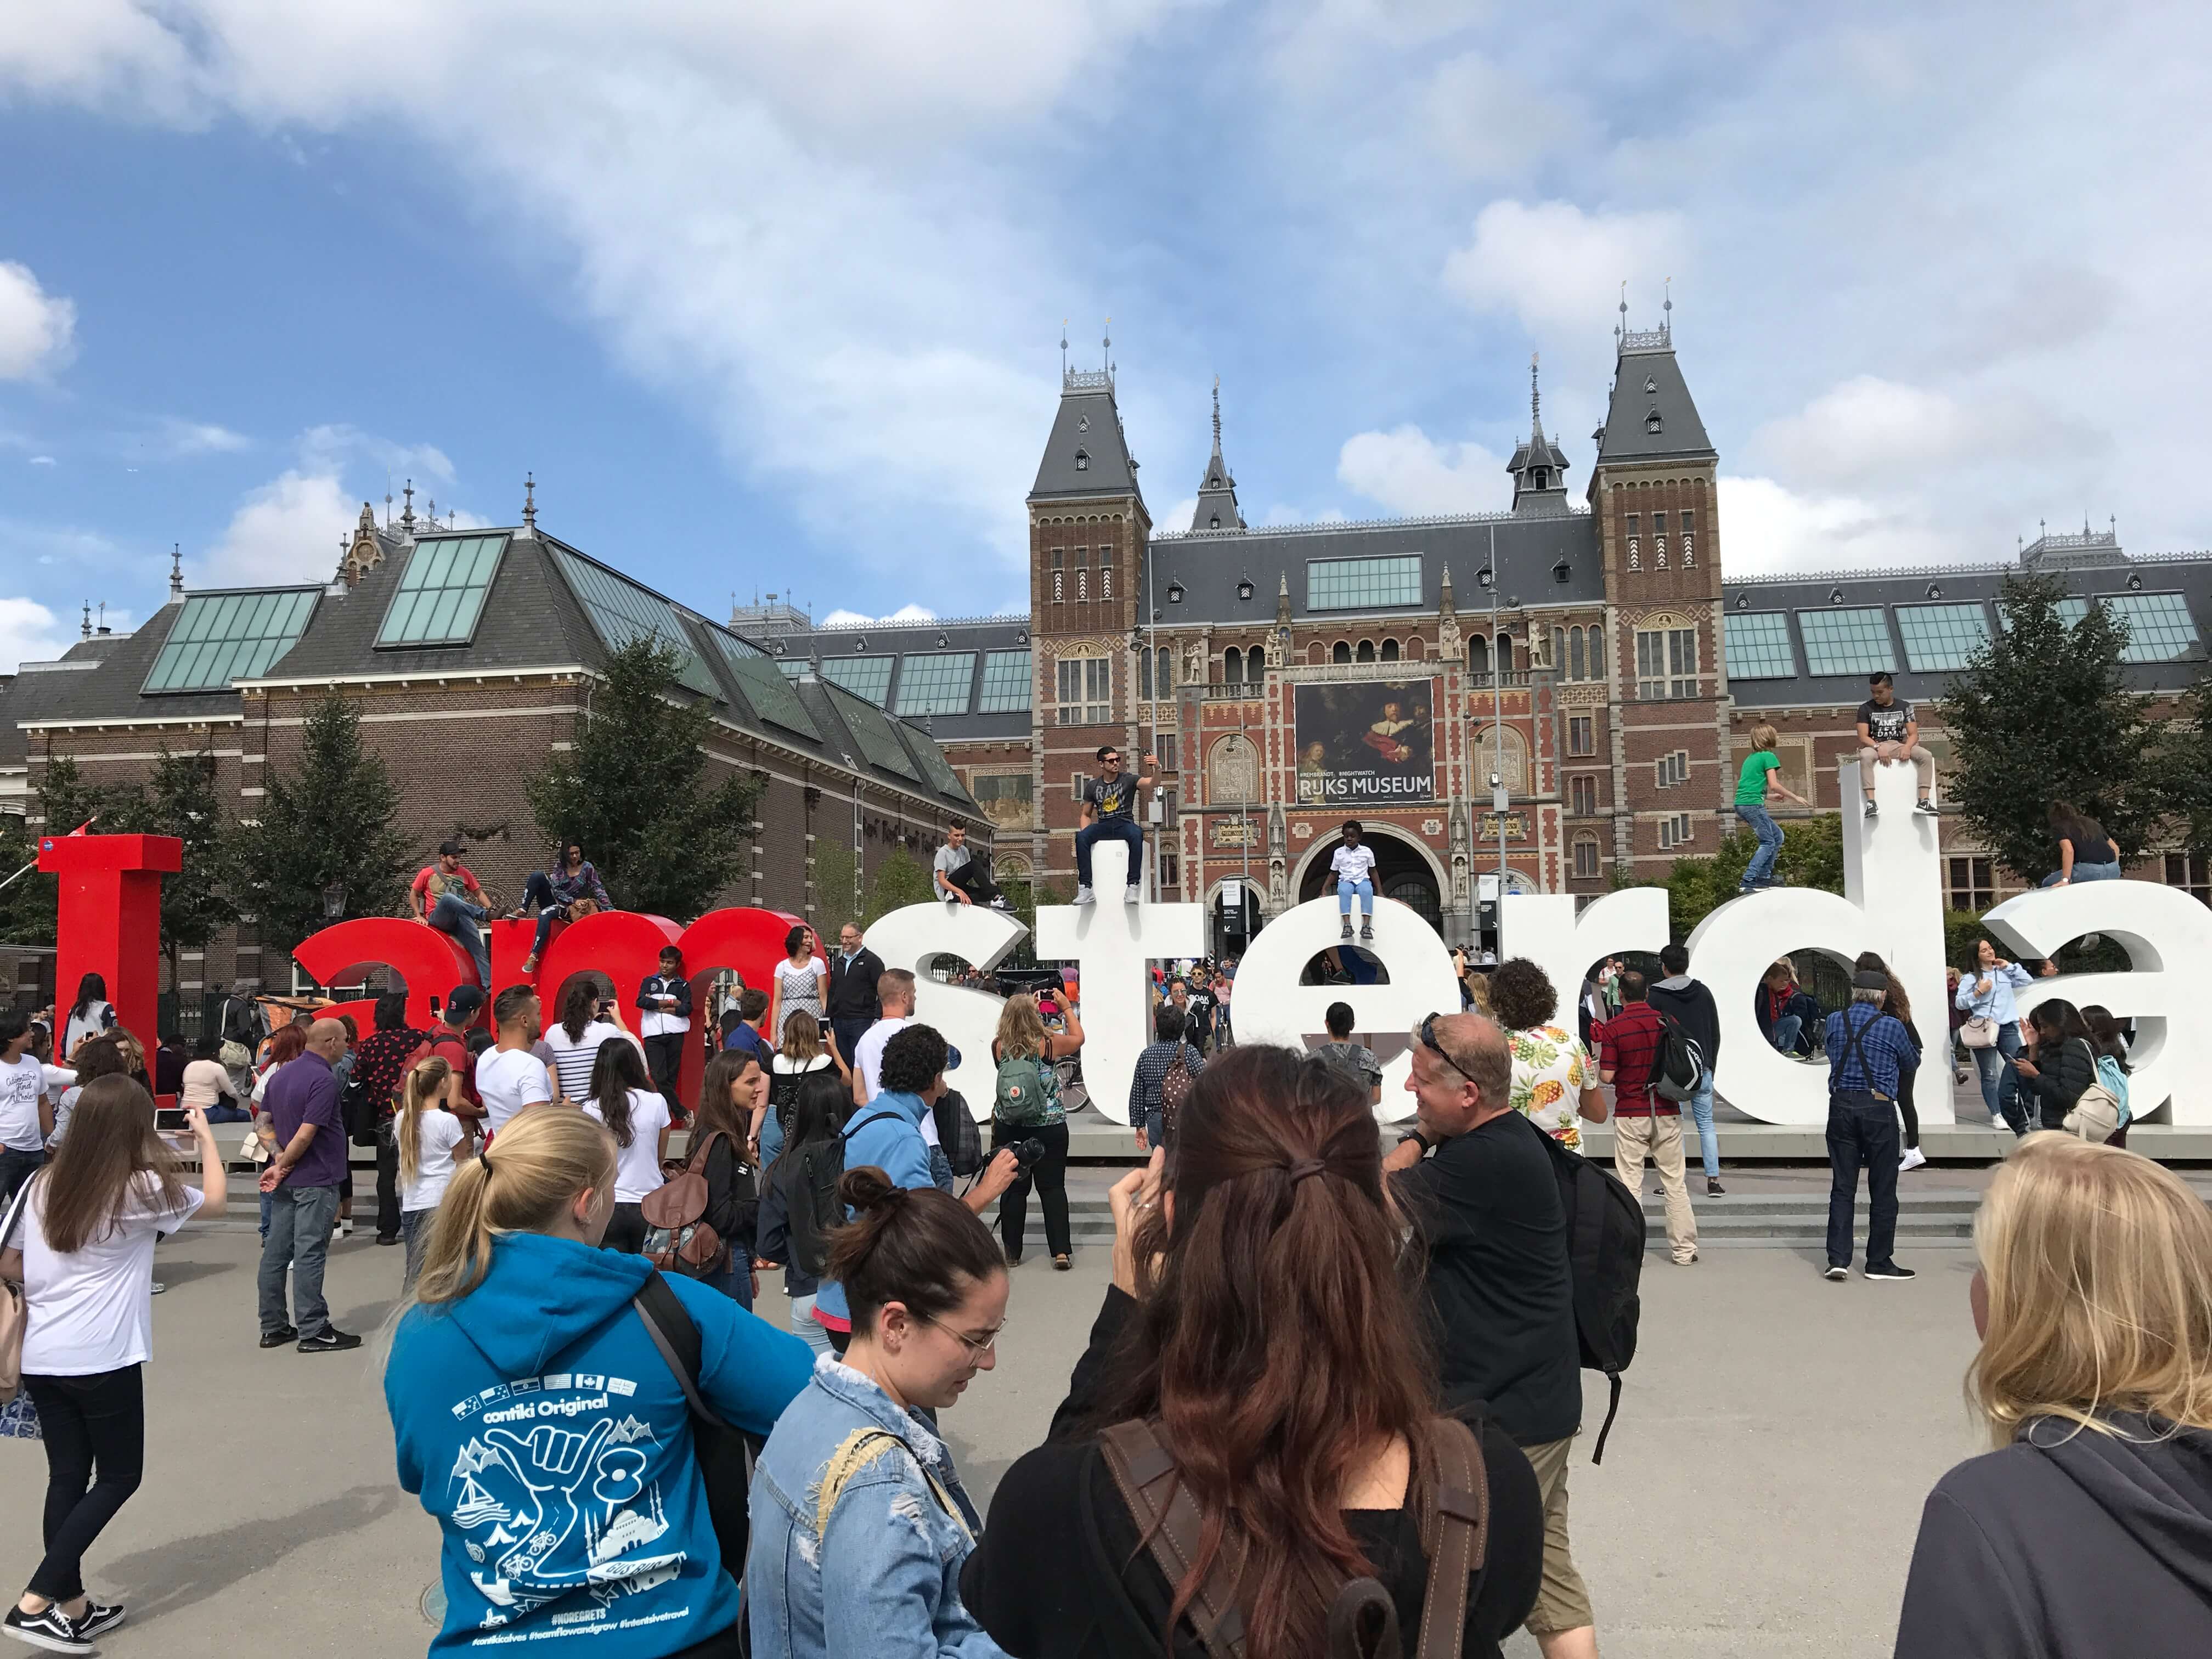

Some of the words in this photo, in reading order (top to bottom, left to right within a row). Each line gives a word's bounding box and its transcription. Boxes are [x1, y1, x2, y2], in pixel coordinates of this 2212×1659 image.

[1352, 776, 1431, 794] MUSEUM
[483, 1402, 535, 1424] contiki
[538, 1392, 608, 1417] Original
[606, 1562, 635, 1575] GUS
[551, 1608, 606, 1627] #NOREGRETS
[529, 1622, 618, 1641] #teamflowandgrow
